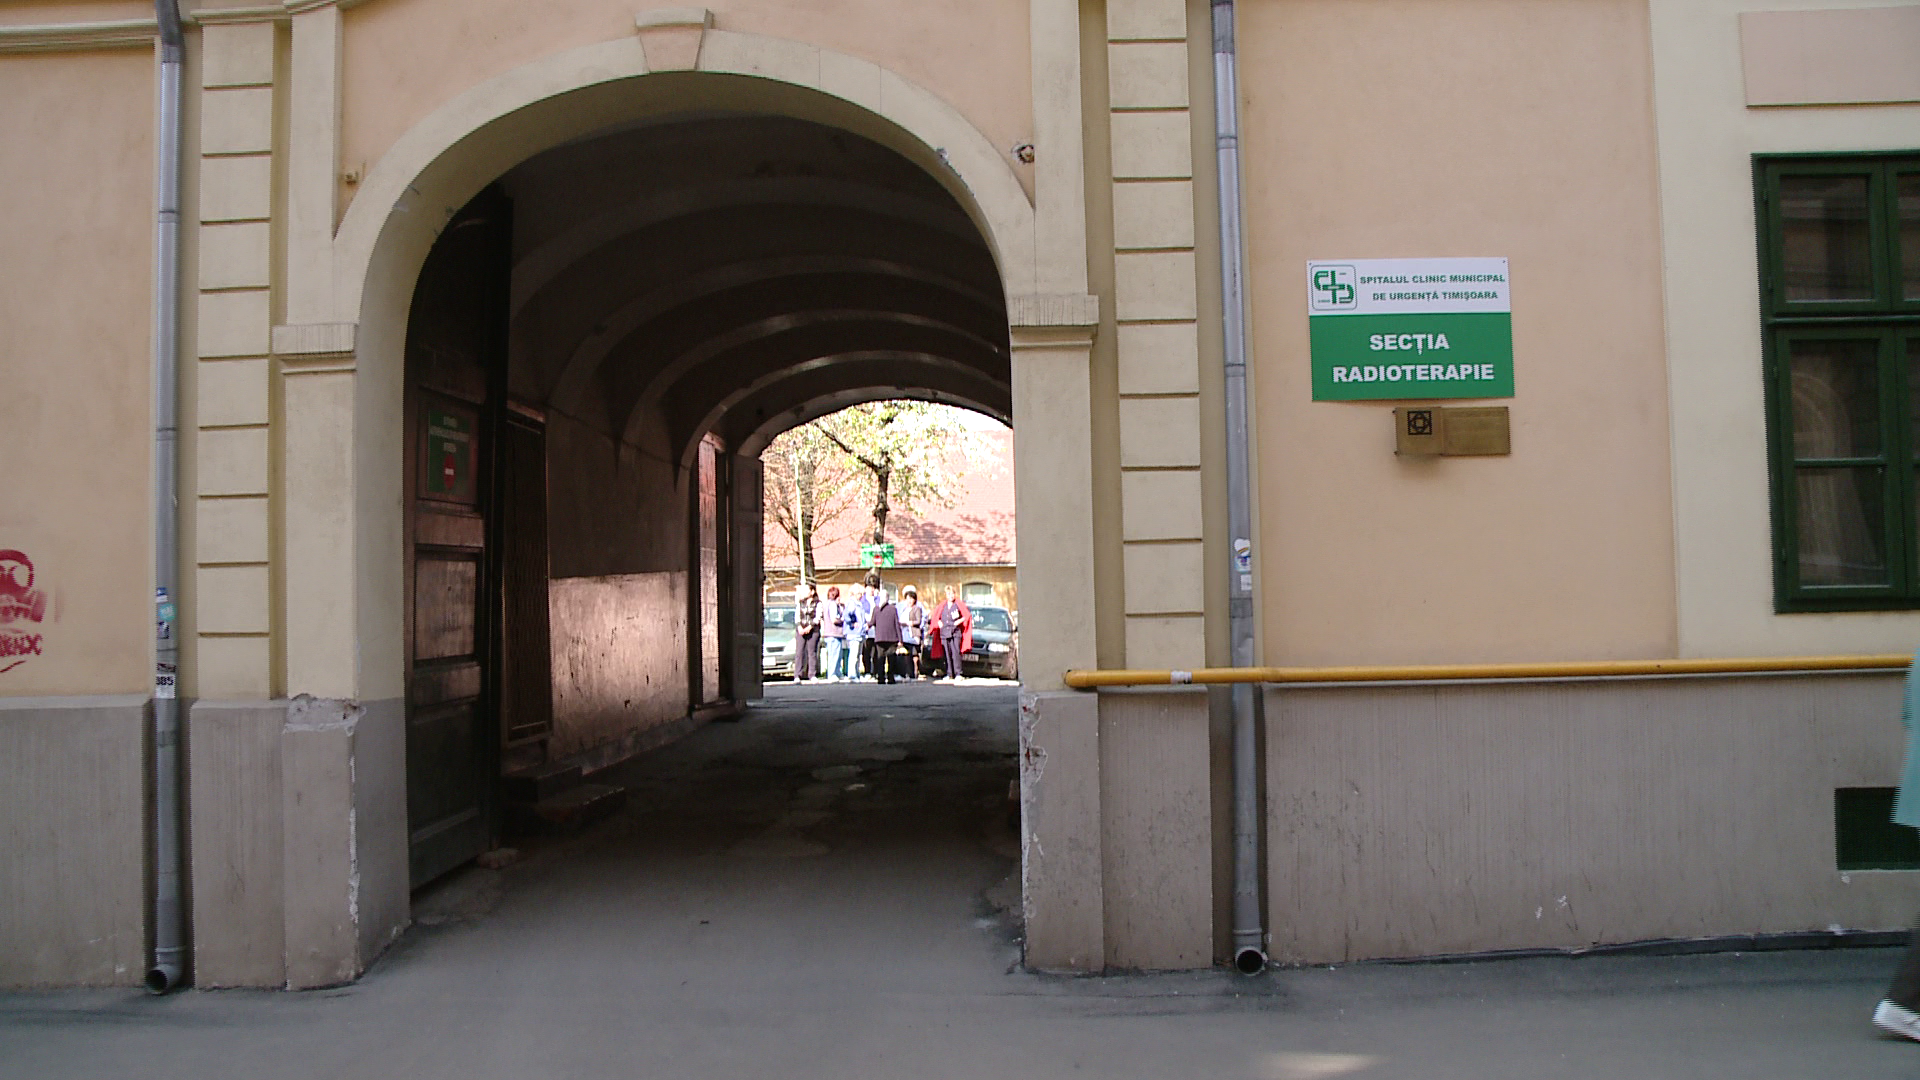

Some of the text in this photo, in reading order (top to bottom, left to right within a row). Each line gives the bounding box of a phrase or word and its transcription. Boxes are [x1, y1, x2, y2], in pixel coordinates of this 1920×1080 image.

[1360, 274, 1505, 284] SPITALUL CLINIC MUNICIPAL
[1373, 292, 1387, 301] DE
[1332, 364, 1494, 382] RADIOTERAPIE
